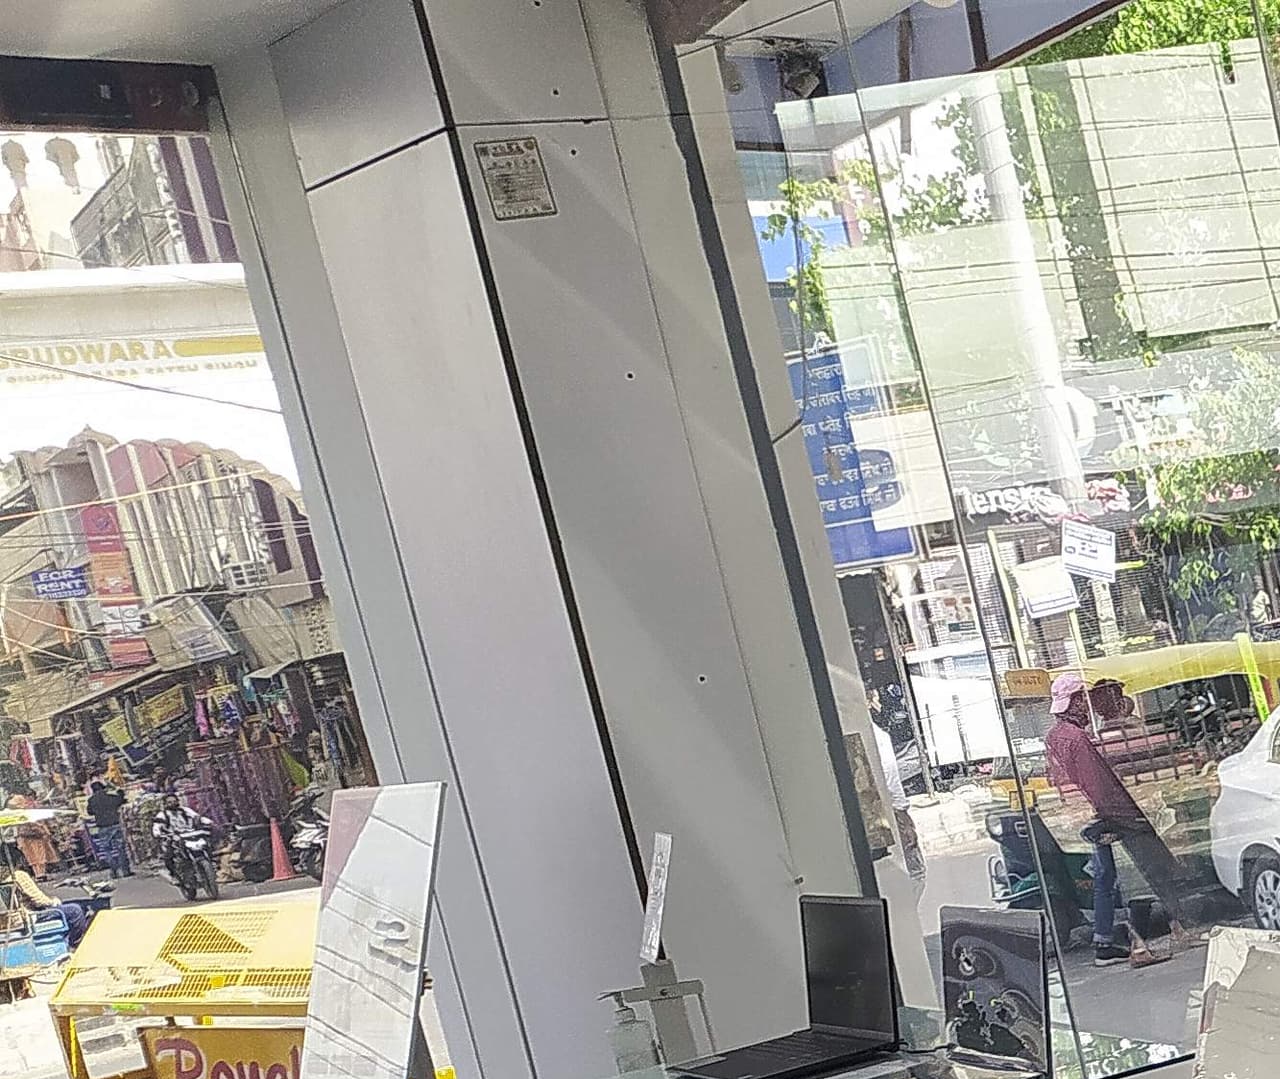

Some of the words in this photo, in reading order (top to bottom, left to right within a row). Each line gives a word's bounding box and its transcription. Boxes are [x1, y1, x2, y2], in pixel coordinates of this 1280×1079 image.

[0, 339, 174, 370] RUDWARA
[38, 569, 75, 582] FOR
[36, 580, 83, 594] RENT
